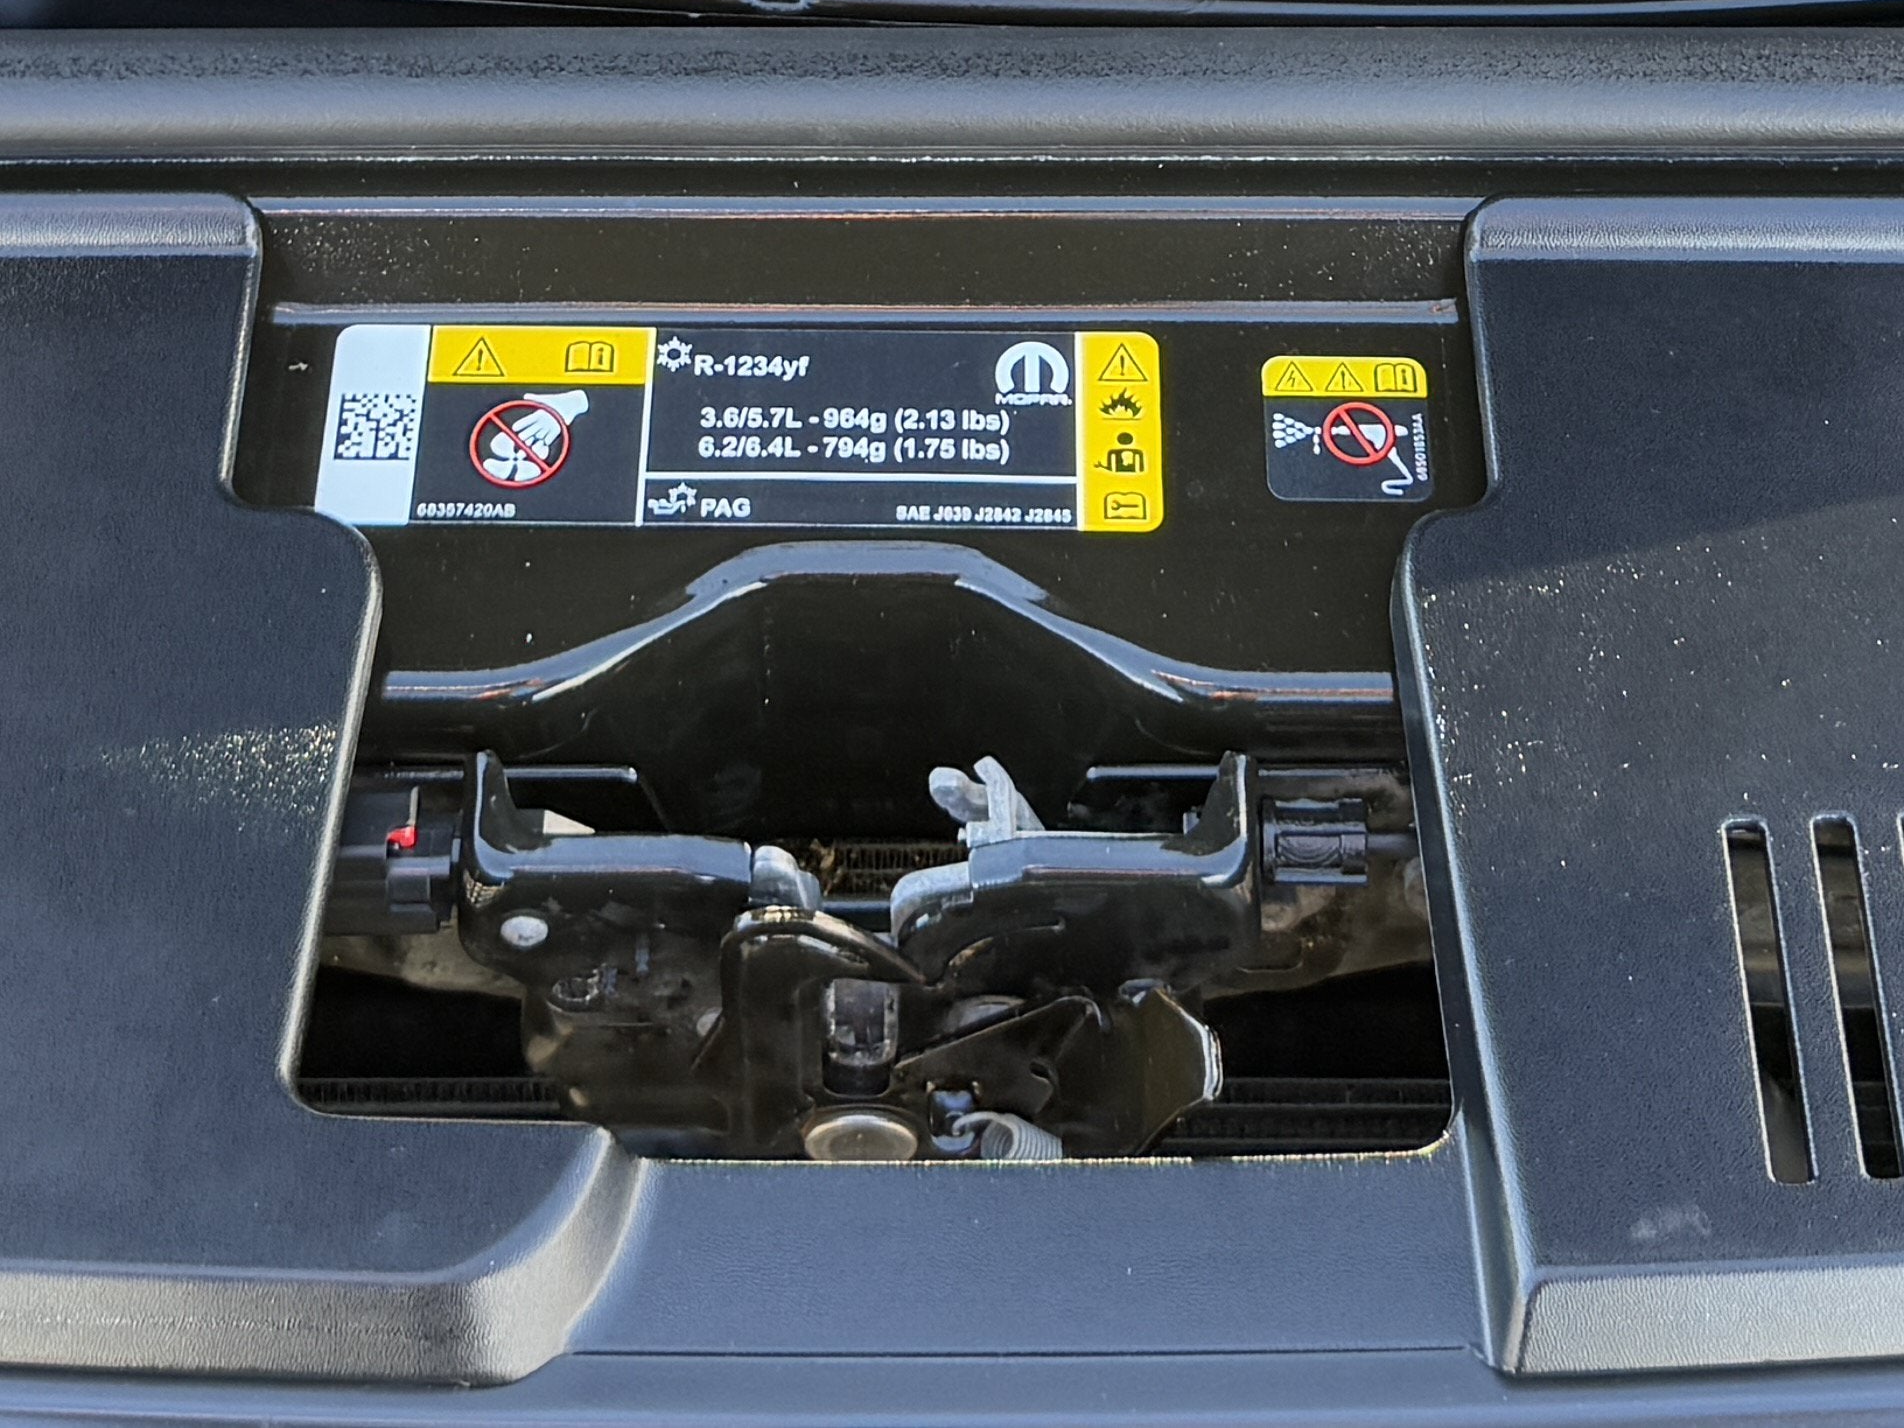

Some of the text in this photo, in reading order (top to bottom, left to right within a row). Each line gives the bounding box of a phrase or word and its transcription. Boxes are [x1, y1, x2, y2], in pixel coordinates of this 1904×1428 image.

[693, 354, 810, 381] R-1234yf
[699, 406, 803, 429] 3.6/5.7L
[822, 407, 888, 434] 964g
[894, 408, 956, 434] (2.13
[961, 409, 1010, 436] lbs)
[697, 435, 802, 459] 6.2/6.4L
[822, 436, 887, 463] 794g
[893, 437, 956, 463] (1.75
[961, 439, 1010, 465] lbs)
[700, 497, 751, 519] PAG
[895, 505, 931, 521] SAE
